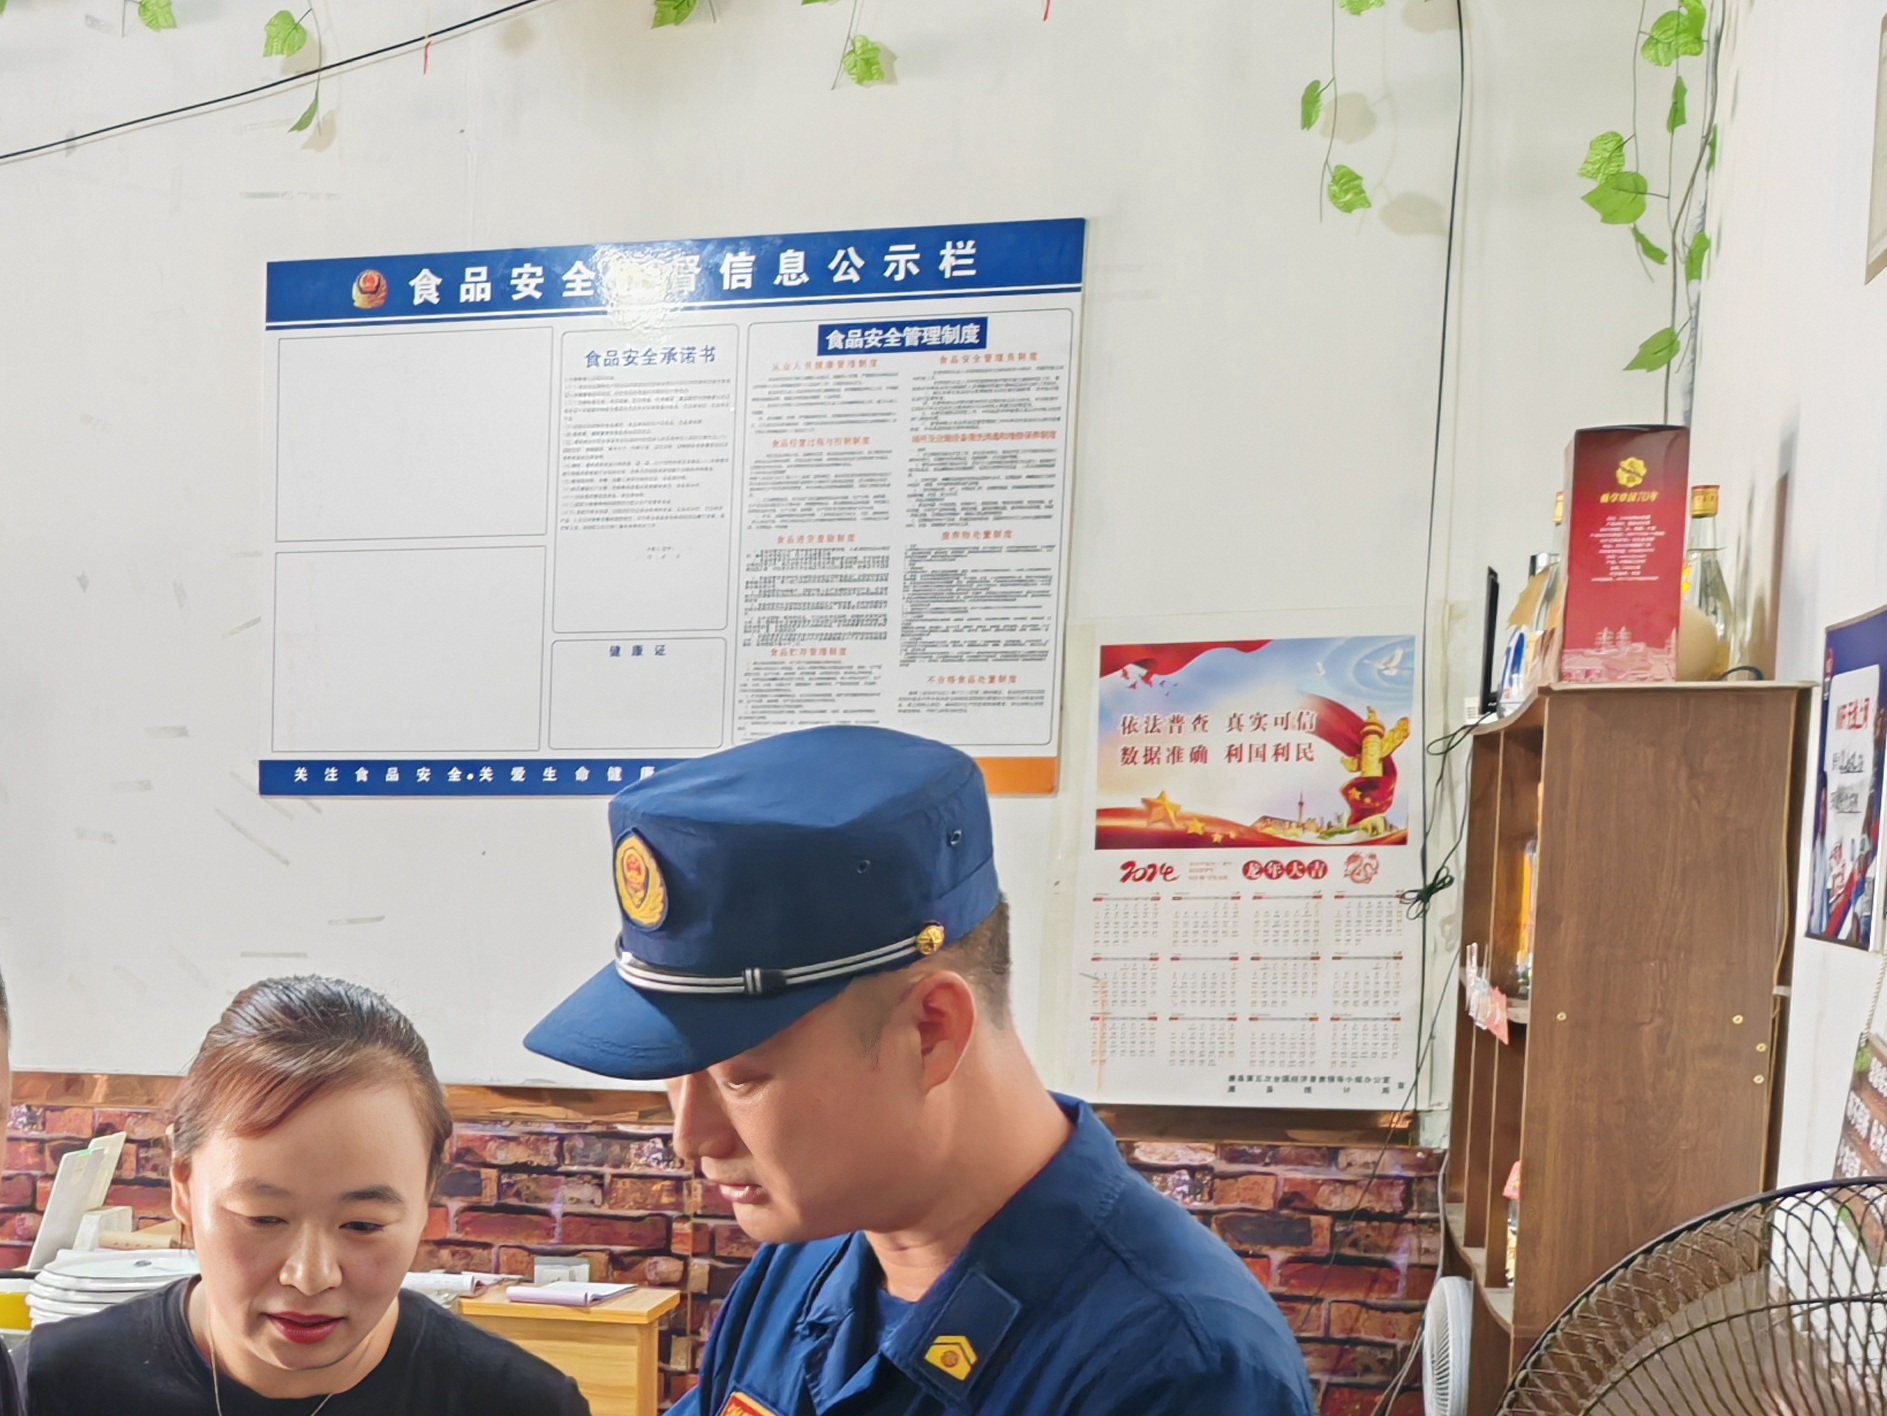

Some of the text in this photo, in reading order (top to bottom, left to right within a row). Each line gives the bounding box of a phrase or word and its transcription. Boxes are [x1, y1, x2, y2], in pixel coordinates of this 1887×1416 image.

[409, 240, 978, 306] 食品安全督信息公示栏
[826, 323, 980, 350] 食品安全管理制度
[585, 344, 716, 368] 食品安全承诺书
[609, 644, 666, 658] 健康证
[1119, 710, 1318, 736] 依法普查 真实可信
[1119, 742, 1315, 766] 数据准确 利国利民
